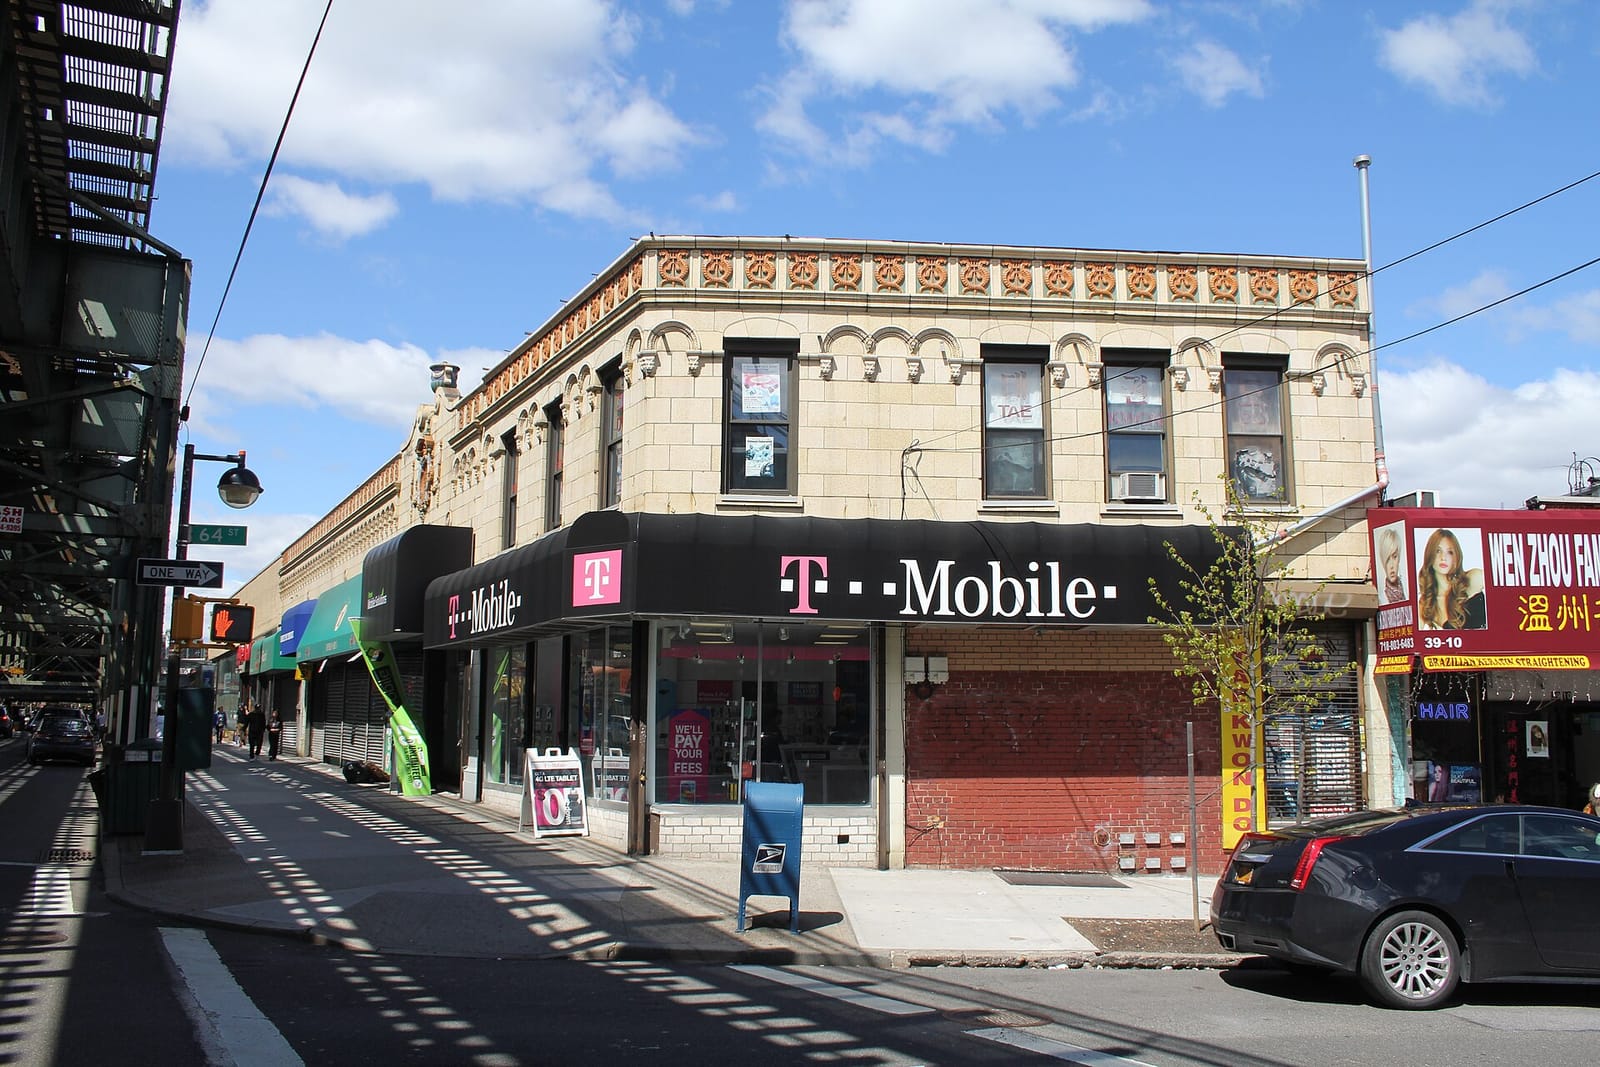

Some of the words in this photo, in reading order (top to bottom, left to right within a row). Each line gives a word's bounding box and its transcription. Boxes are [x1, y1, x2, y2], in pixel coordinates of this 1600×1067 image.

[998, 404, 1033, 419] TAE
[0, 507, 22, 516] SH
[0, 516, 22, 524] ARS
[200, 527, 223, 542] 64
[228, 528, 239, 537] ST
[1488, 532, 1526, 587] WEN
[1526, 532, 1572, 588] ZHOU
[150, 567, 174, 578] ONE
[185, 568, 209, 580] WAY
[579, 557, 610, 599] T
[1424, 637, 1462, 648] 39-10
[1427, 656, 1476, 668] BRAZILIAN
[1478, 657, 1514, 667] KERATIN
[1516, 657, 1586, 668] STRAIGHTENING
[1419, 703, 1469, 719] HAIR
[675, 725, 703, 735] WE'LL
[674, 735, 703, 749] PAY
[674, 749, 703, 759] YOUR
[674, 763, 703, 774] FEES
[555, 774, 578, 782] TABLET
[1233, 798, 1250, 831] DO
